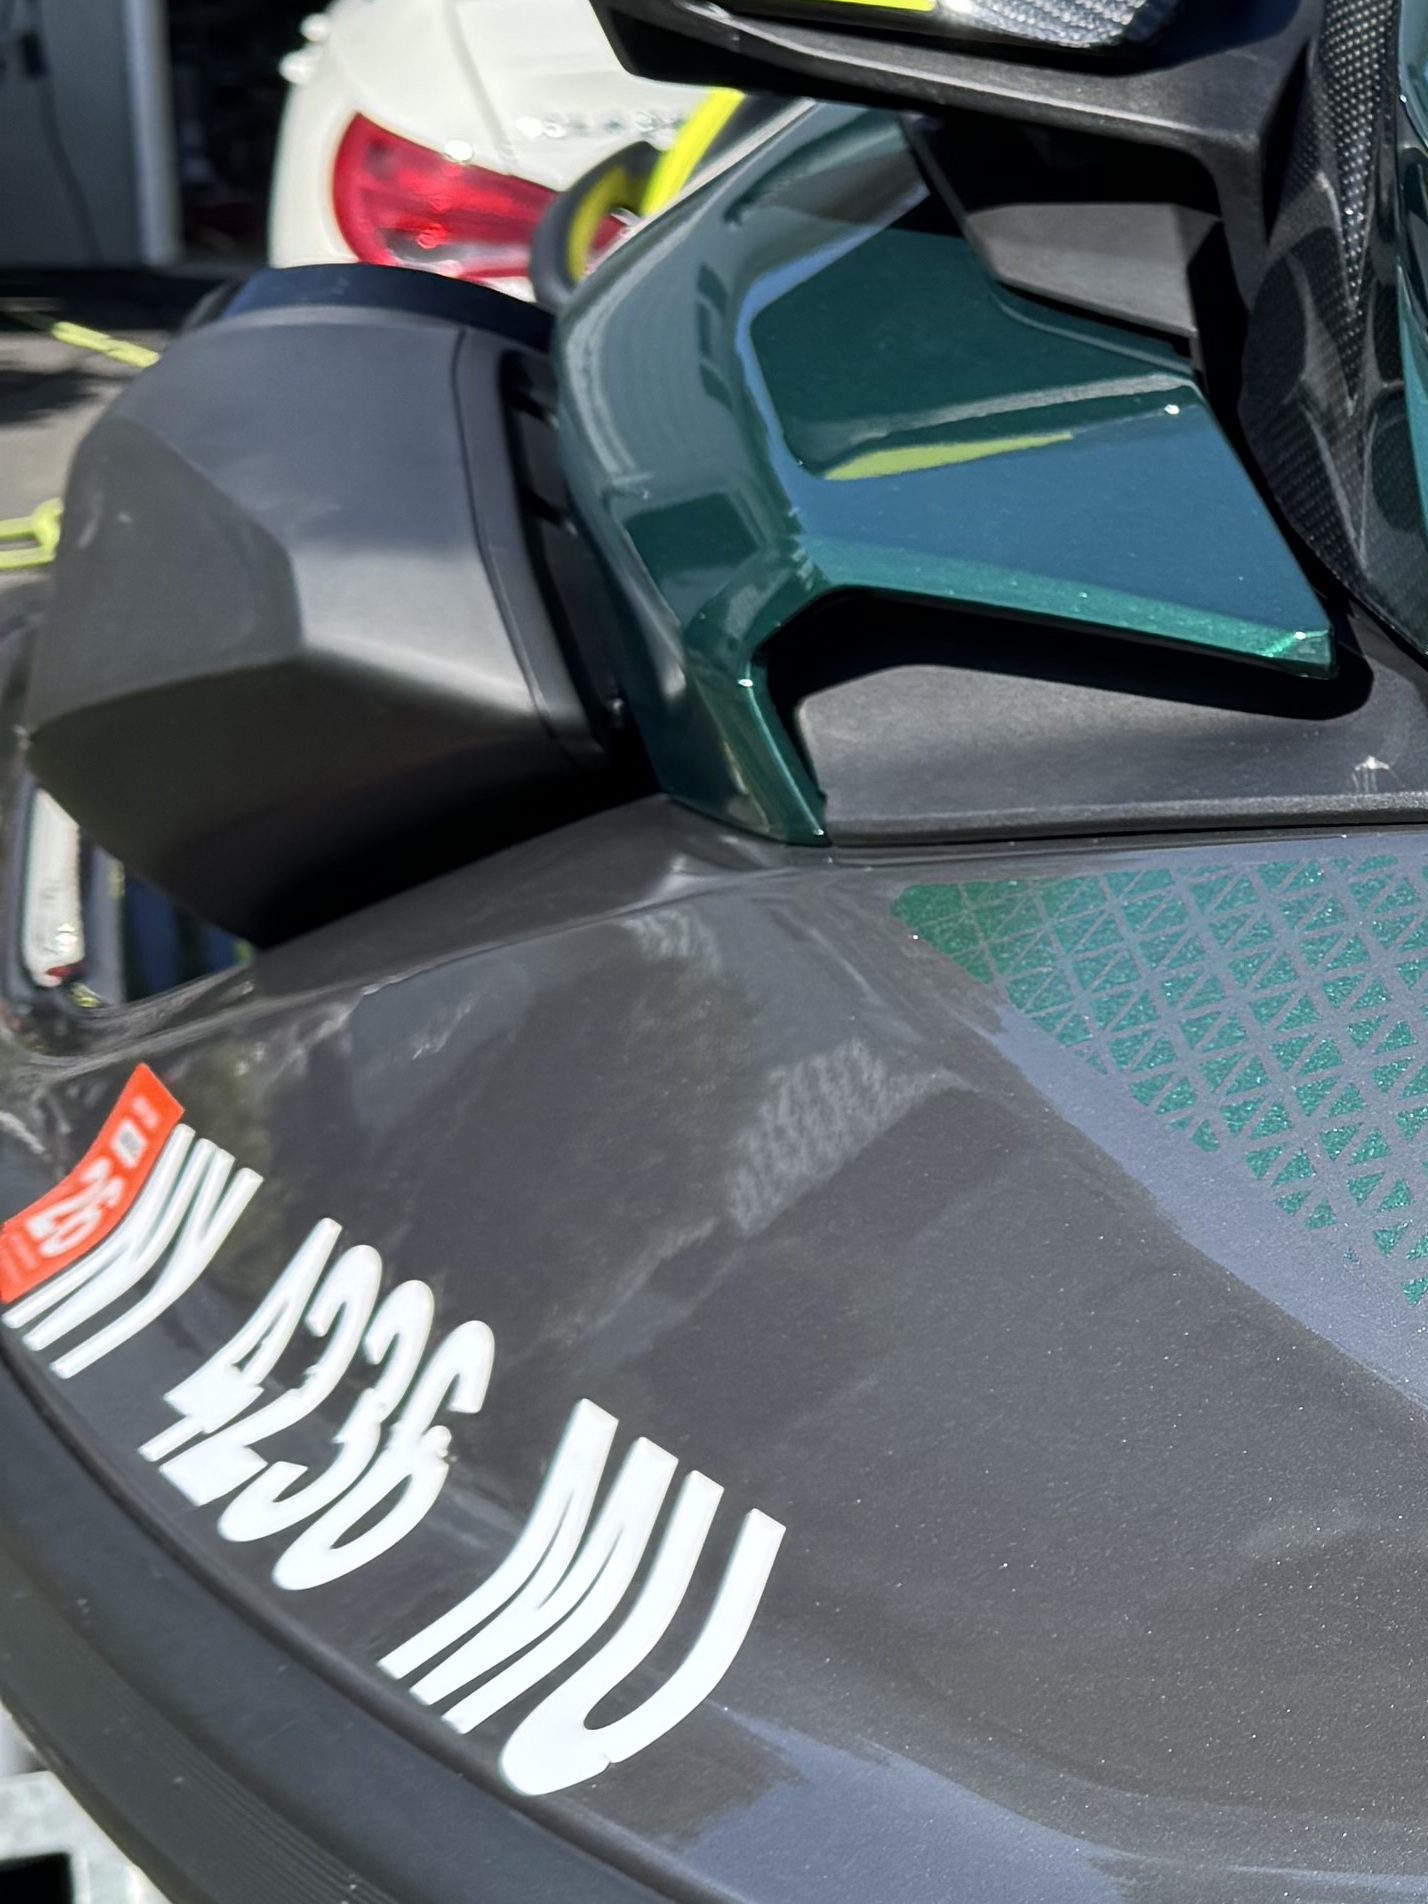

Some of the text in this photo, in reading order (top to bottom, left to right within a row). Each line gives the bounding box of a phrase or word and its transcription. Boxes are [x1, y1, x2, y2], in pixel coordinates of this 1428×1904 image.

[1, 1123, 786, 1796] NY 4236 MU
